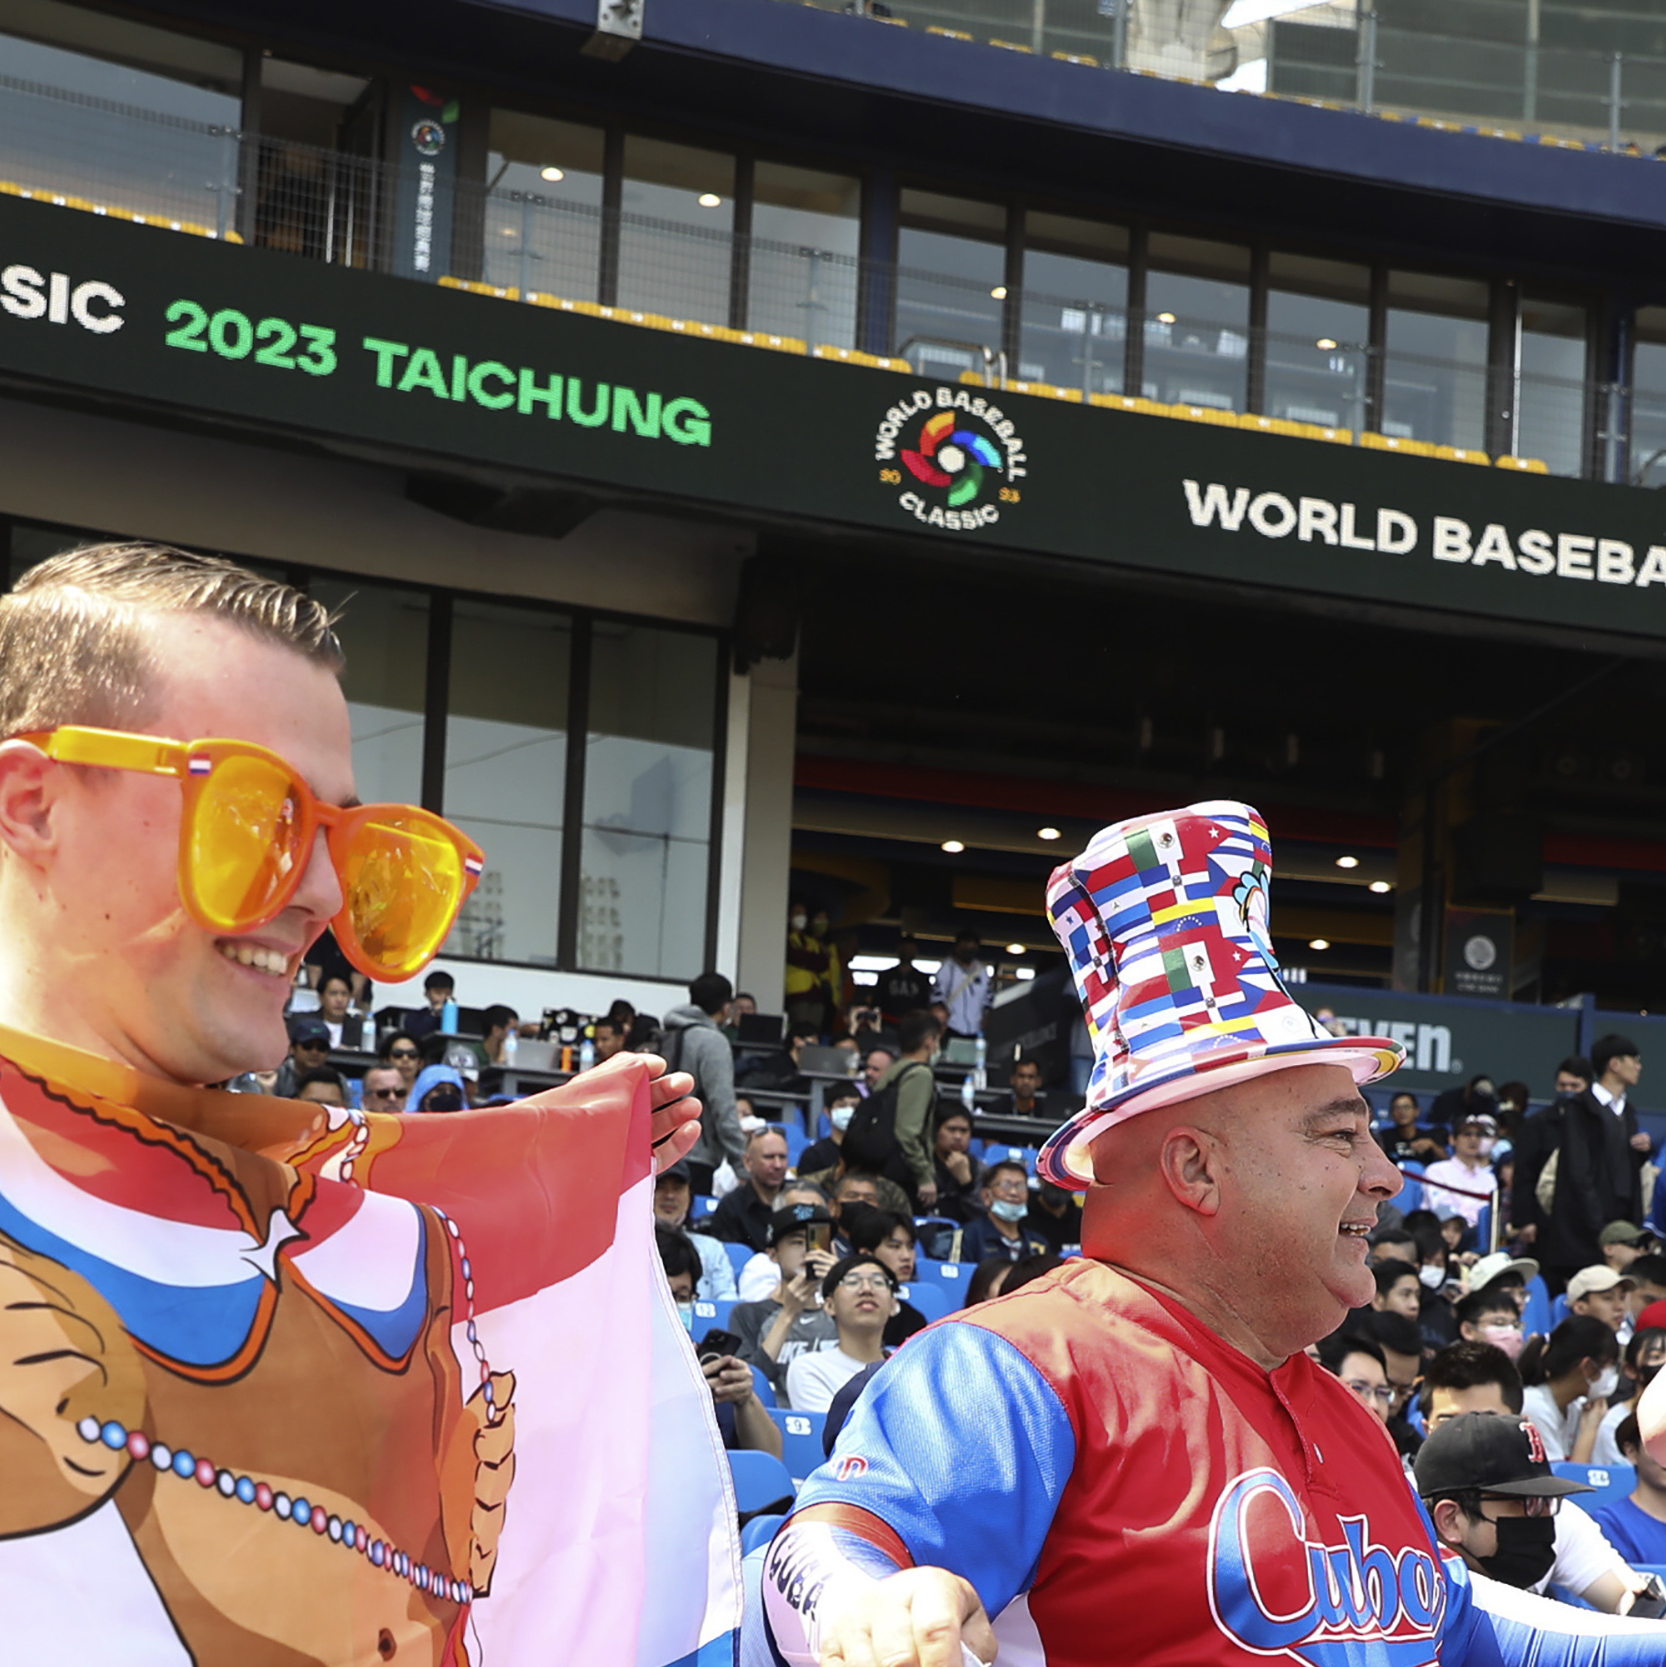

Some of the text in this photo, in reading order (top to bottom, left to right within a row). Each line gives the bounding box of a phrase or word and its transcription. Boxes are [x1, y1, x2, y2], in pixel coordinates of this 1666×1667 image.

[165, 299, 338, 376] 2023
[363, 337, 712, 447] TAICHUNG
[875, 386, 1027, 482] WORLD BASEBALL
[899, 491, 999, 530] CLASSIC
[1182, 479, 1418, 555] WORLD
[793, 1419, 803, 1433] 9
[1207, 1467, 1447, 1657] Cuba
